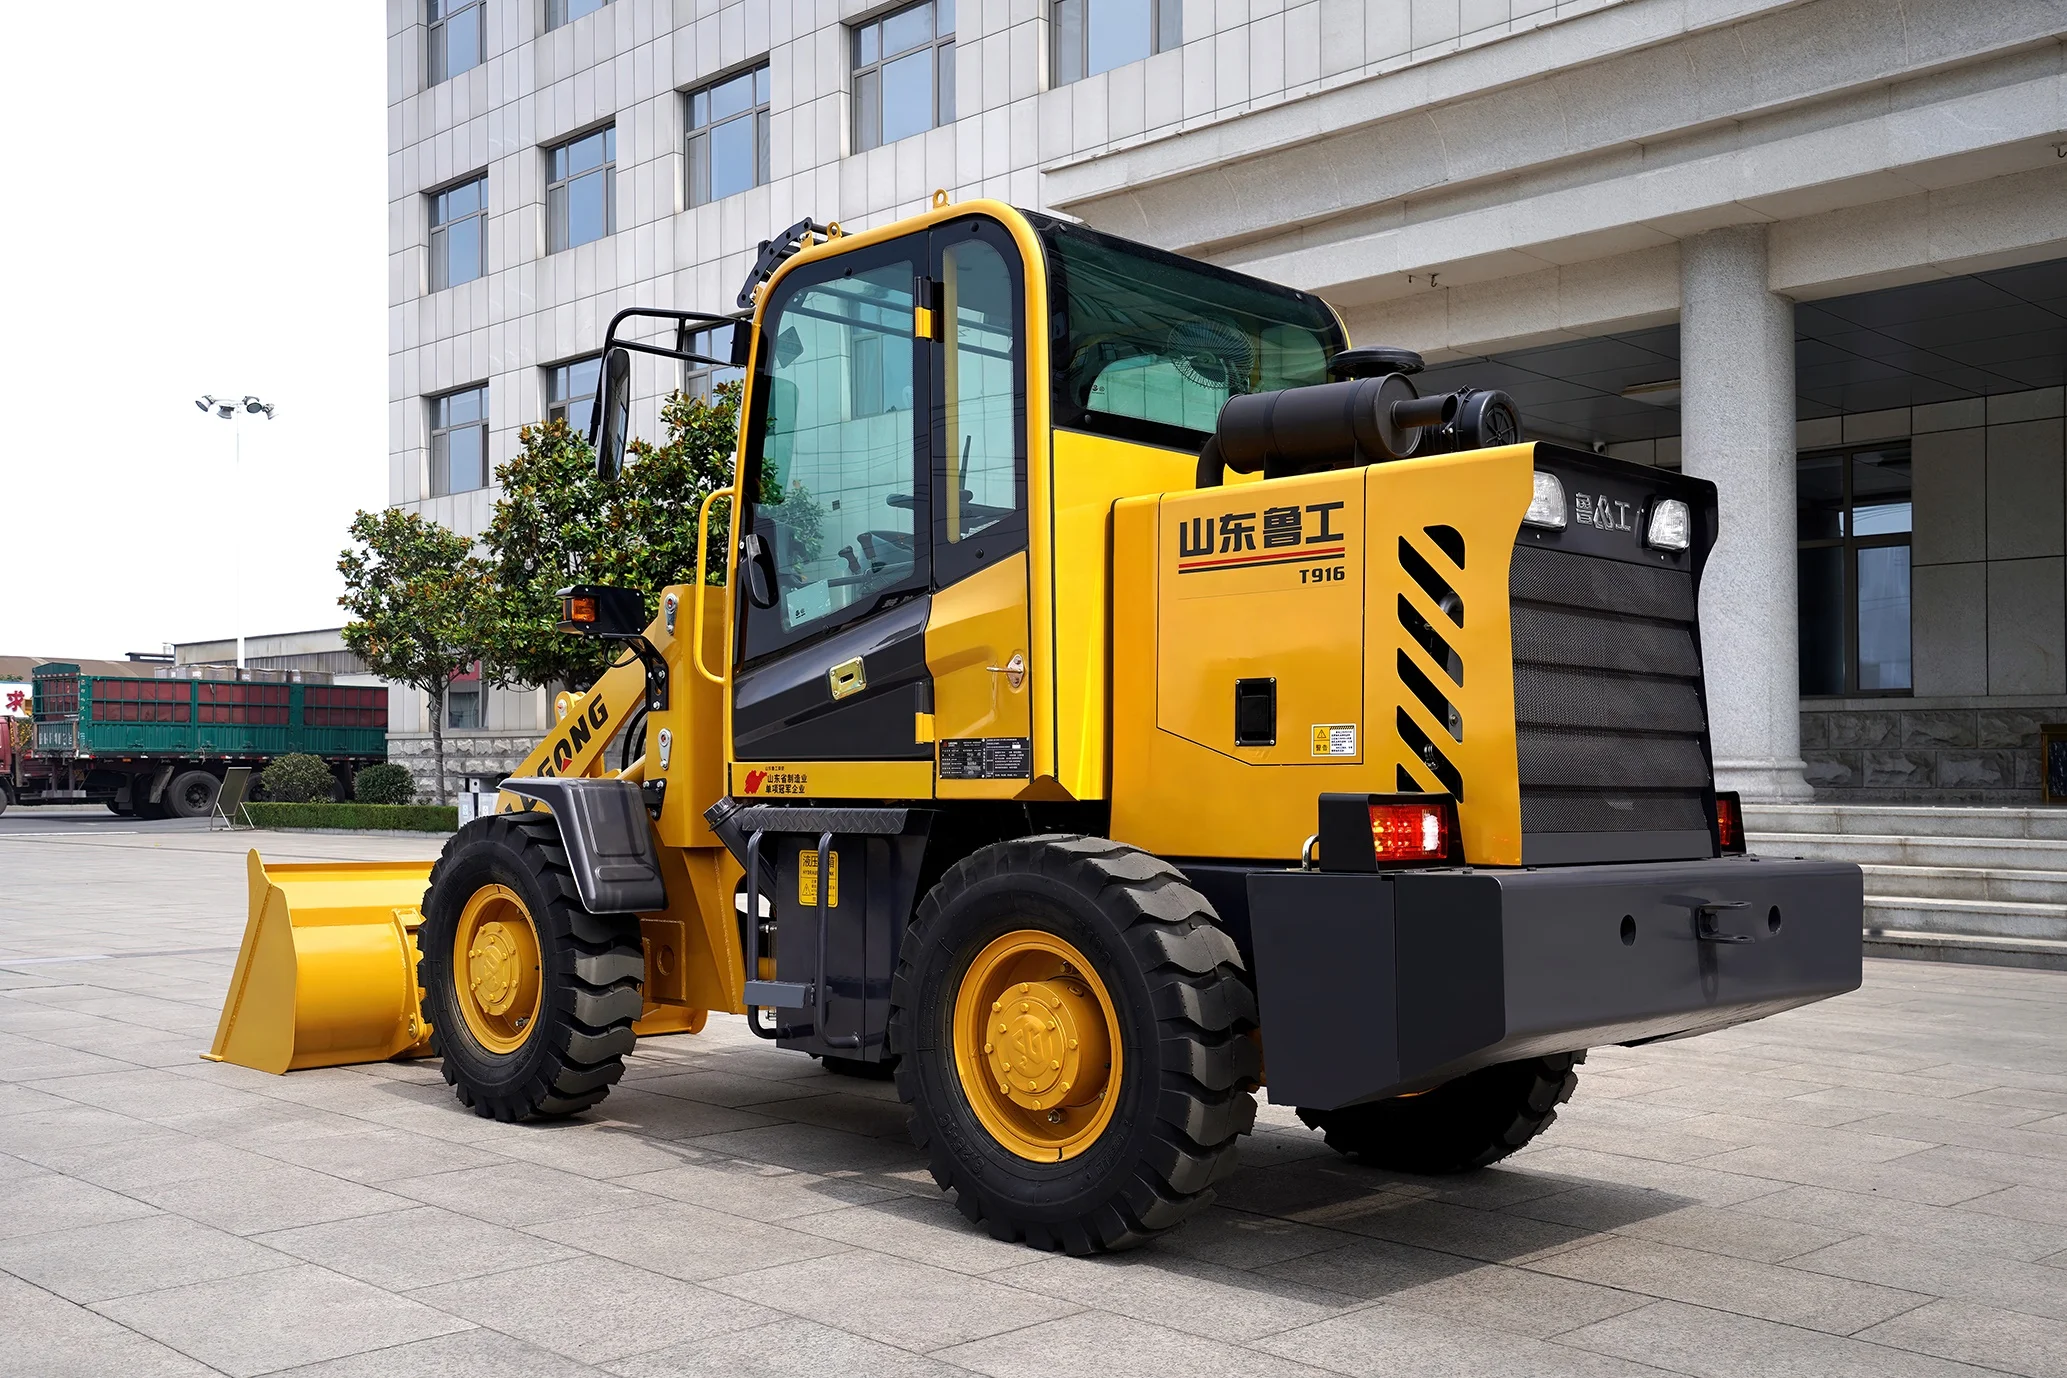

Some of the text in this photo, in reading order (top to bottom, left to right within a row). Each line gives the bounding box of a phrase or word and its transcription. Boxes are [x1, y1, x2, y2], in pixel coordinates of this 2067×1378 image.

[1180, 501, 1344, 558] 山东鲁工
[1299, 566, 1345, 584] T916
[6, 690, 25, 712] 求
[767, 774, 807, 783] 山东省制造业
